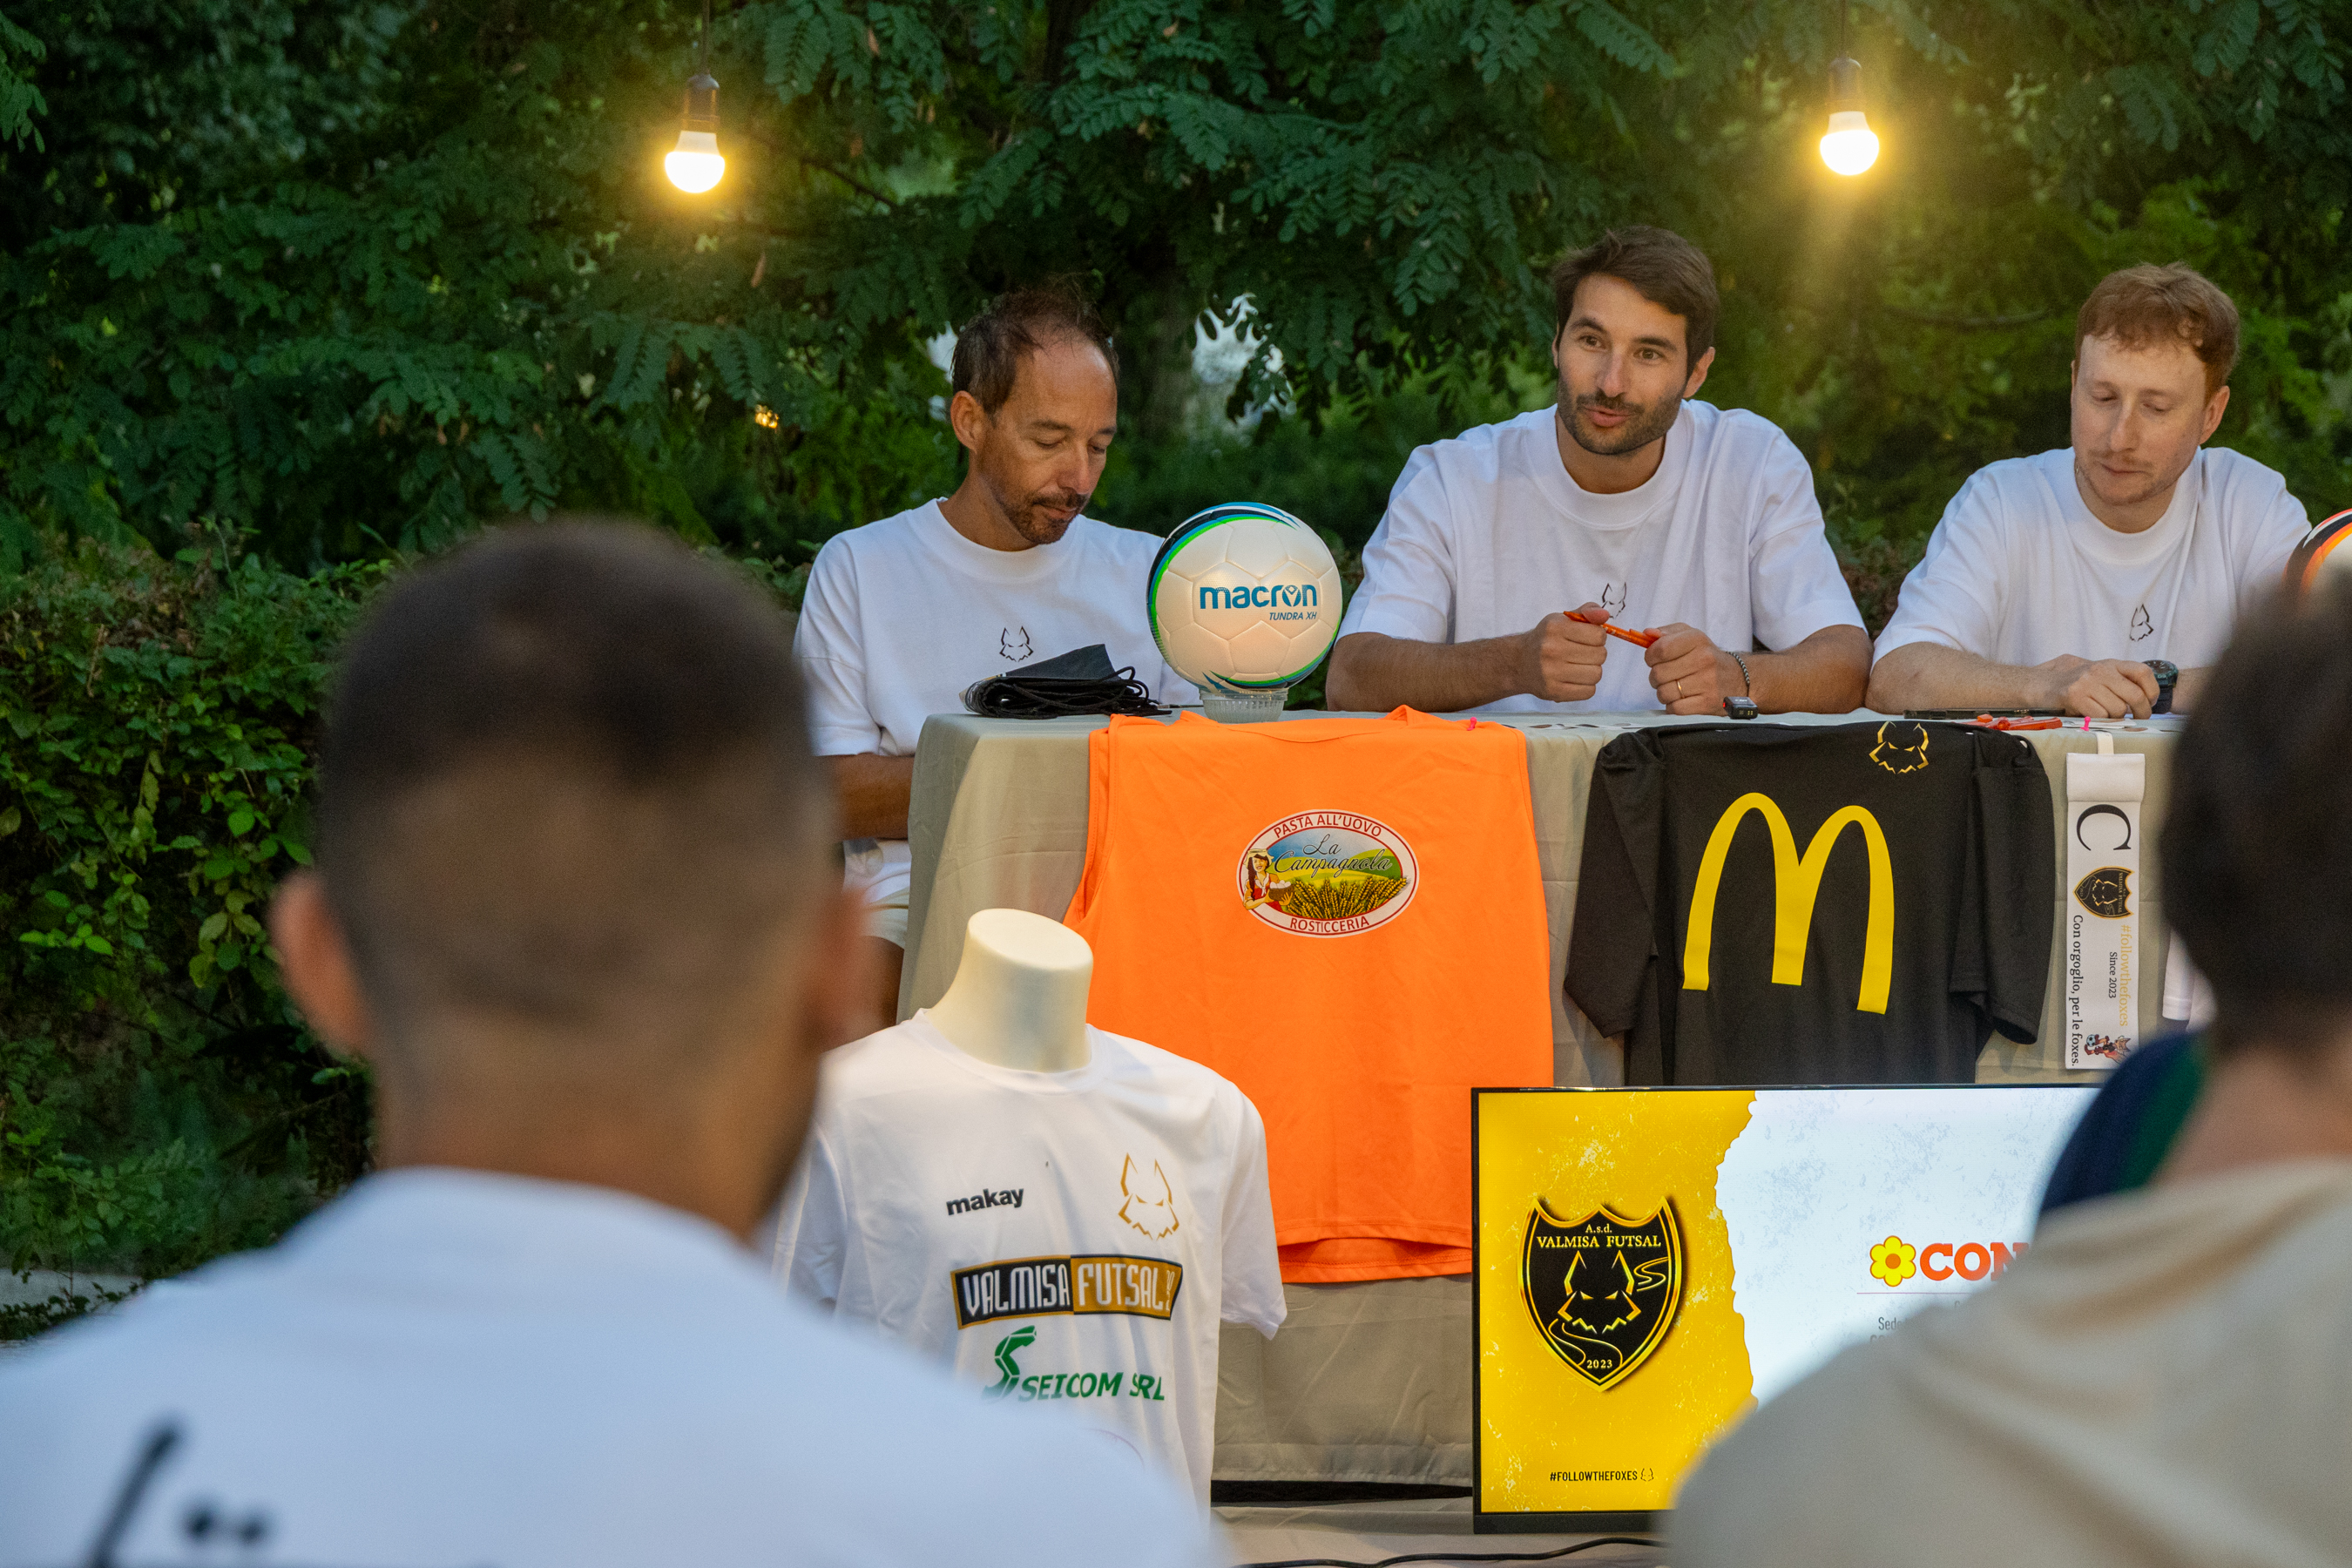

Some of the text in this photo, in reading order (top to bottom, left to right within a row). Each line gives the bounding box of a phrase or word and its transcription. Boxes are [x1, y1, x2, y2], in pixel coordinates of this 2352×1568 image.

[1200, 585, 1317, 609] macron
[1268, 611, 1317, 621] TUNDRA XH
[1273, 814, 1382, 839] PASTA ALL'UOVO
[2076, 803, 2132, 851] C
[1302, 834, 1342, 855] La
[1274, 848, 1394, 878] Campagnola
[1289, 916, 1370, 933] ROSTICCERIA
[2108, 951, 2118, 998] Since 2023
[2119, 924, 2132, 1027] #followthefoxes
[2069, 915, 2084, 1066] Con orgoglio, per le foxes.
[946, 1188, 1024, 1215] makay
[1585, 1223, 1612, 1233] A.s.d.
[1537, 1235, 1661, 1248] VALMISA FUTSAL
[963, 1263, 1071, 1317] VALMISA
[1077, 1262, 1163, 1311] FUTSAL
[1586, 1359, 1612, 1369] 2023
[1017, 1372, 1165, 1402] SEICOM SRL
[1550, 1470, 1638, 1481] #FOLLOWTHEFOXES
